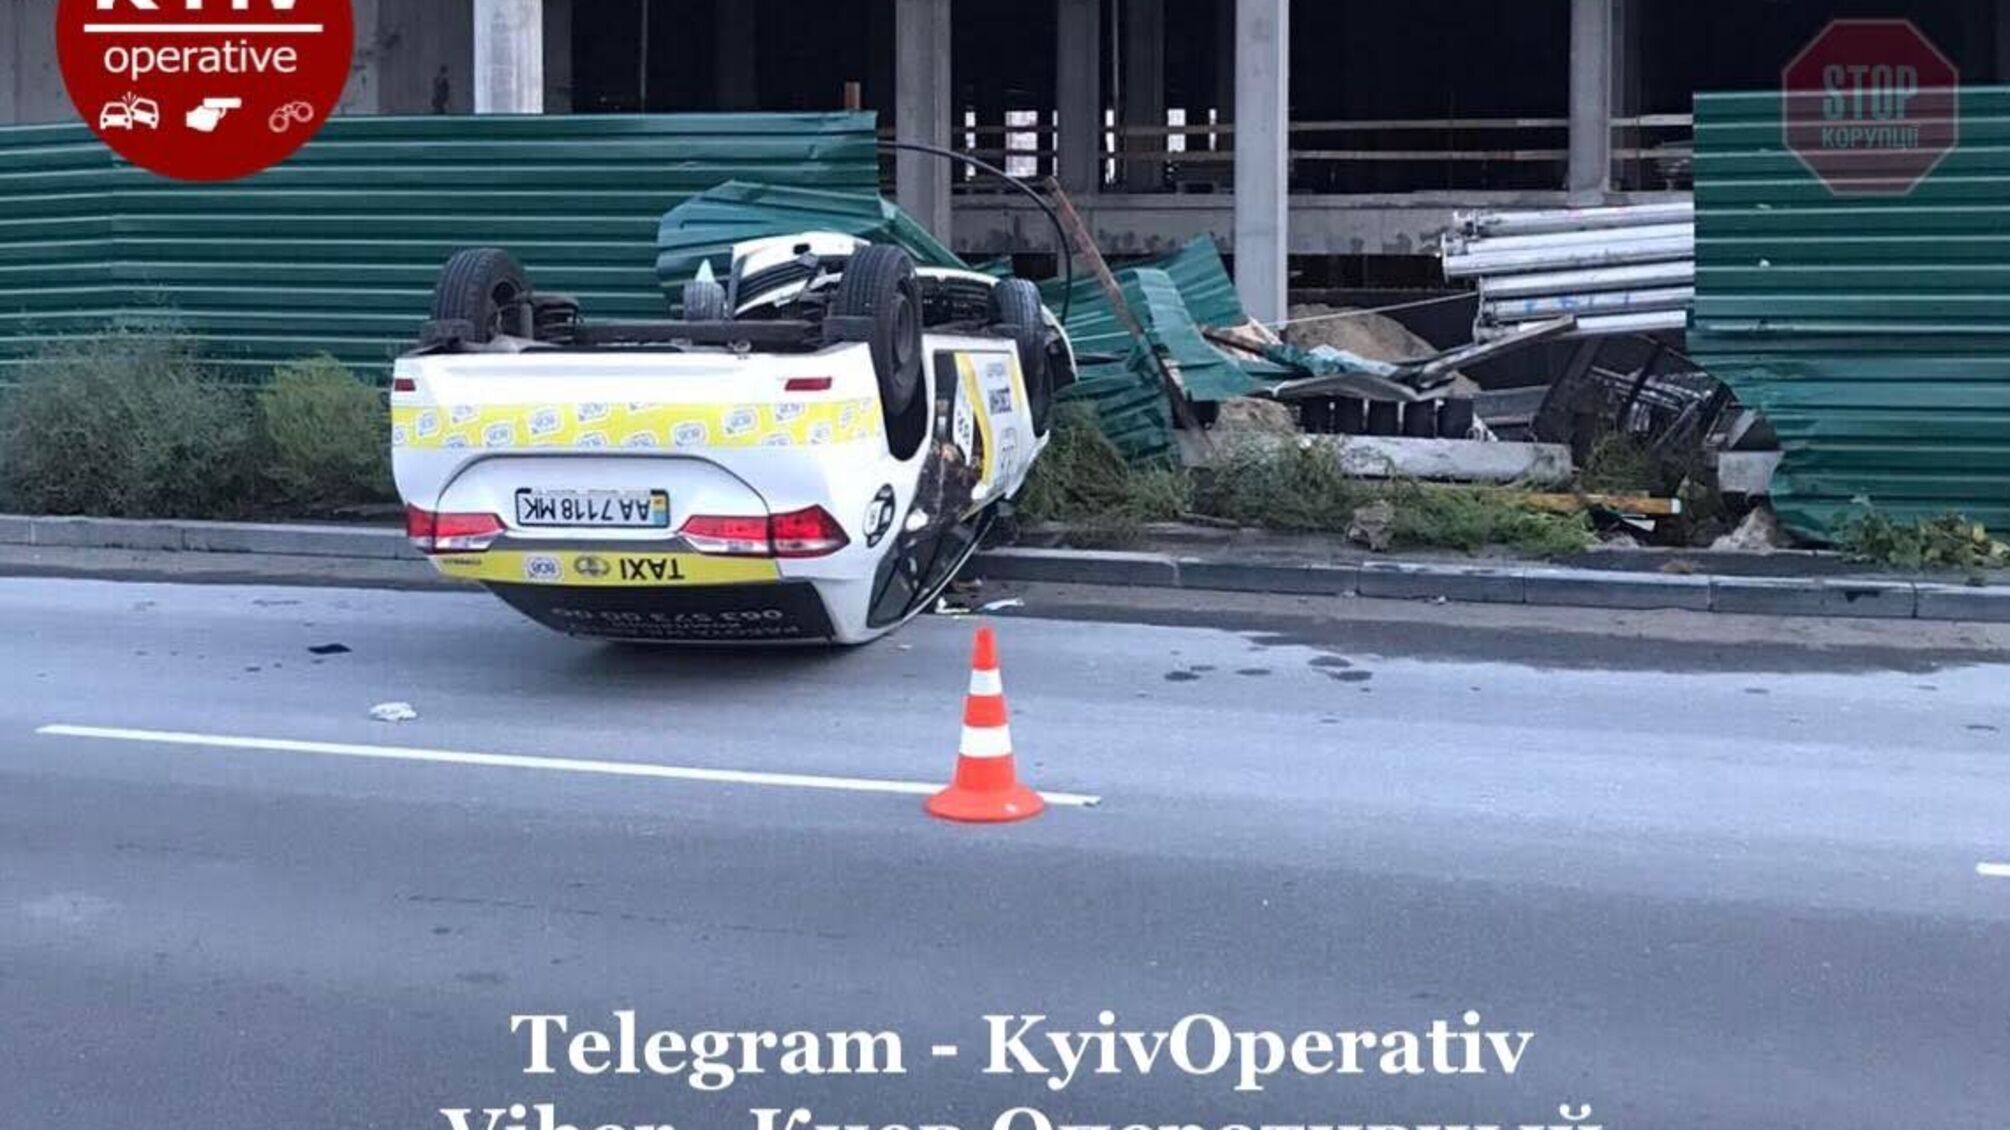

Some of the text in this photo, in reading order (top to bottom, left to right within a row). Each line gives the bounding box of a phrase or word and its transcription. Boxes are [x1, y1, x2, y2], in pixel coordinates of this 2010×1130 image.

[524, 498, 651, 521] AA 7118 MK
[620, 557, 685, 580] TAXI
